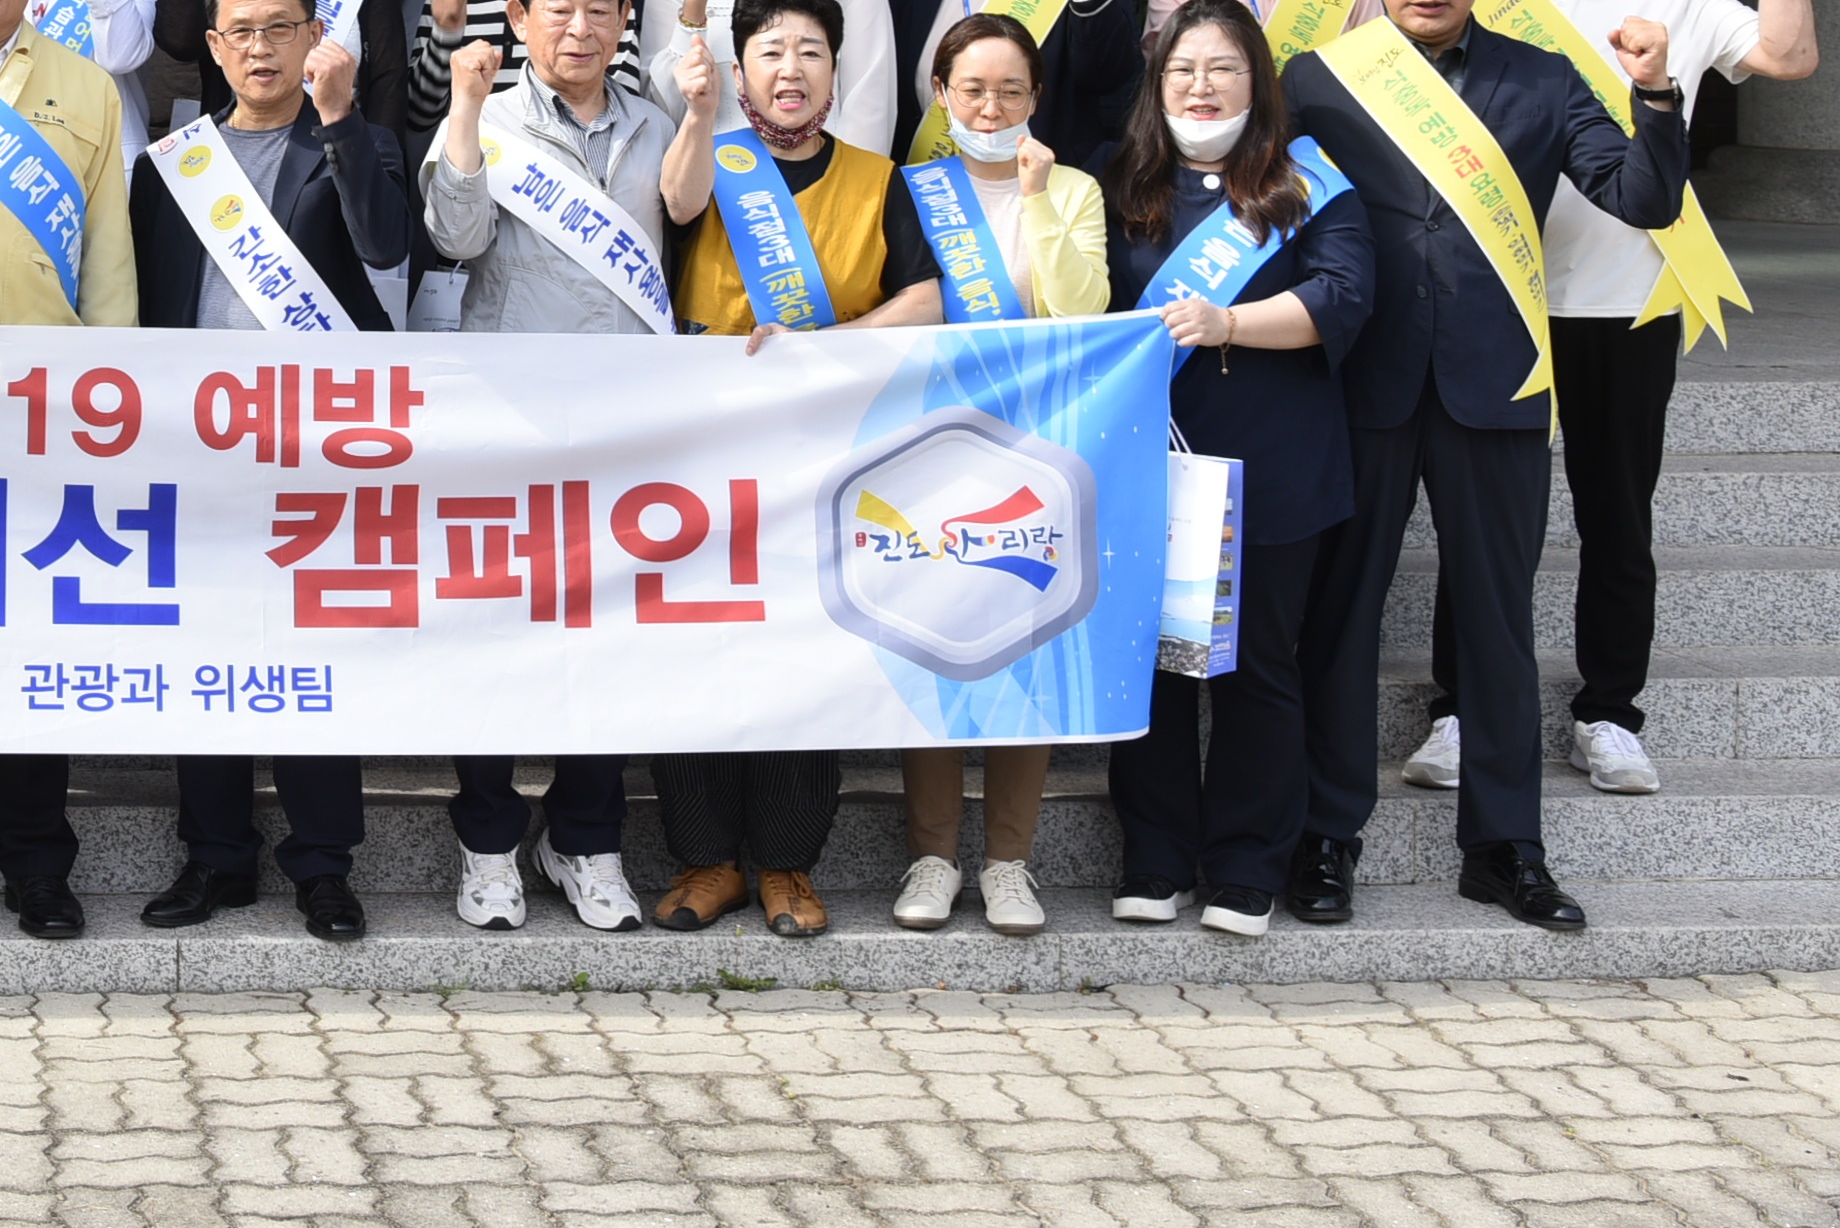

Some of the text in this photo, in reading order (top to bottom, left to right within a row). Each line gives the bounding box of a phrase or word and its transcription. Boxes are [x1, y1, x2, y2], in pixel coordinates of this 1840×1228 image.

[1289, 1, 1326, 45] 식중독
[1383, 70, 1431, 117] 식중독
[1418, 112, 1458, 148] 예방
[1447, 145, 1484, 178] 3대
[10, 156, 60, 205] 음식
[511, 162, 566, 213] 남은
[559, 197, 612, 245] 음식
[910, 166, 968, 228] 음식점3대
[228, 225, 296, 300] 간소한
[737, 190, 796, 268] 음식점3대
[1188, 237, 1241, 291] 음식
[193, 363, 424, 470] 예방
[264, 477, 766, 629] 캠페인
[19, 662, 170, 713] 관광과
[191, 663, 335, 714] 위생팀
